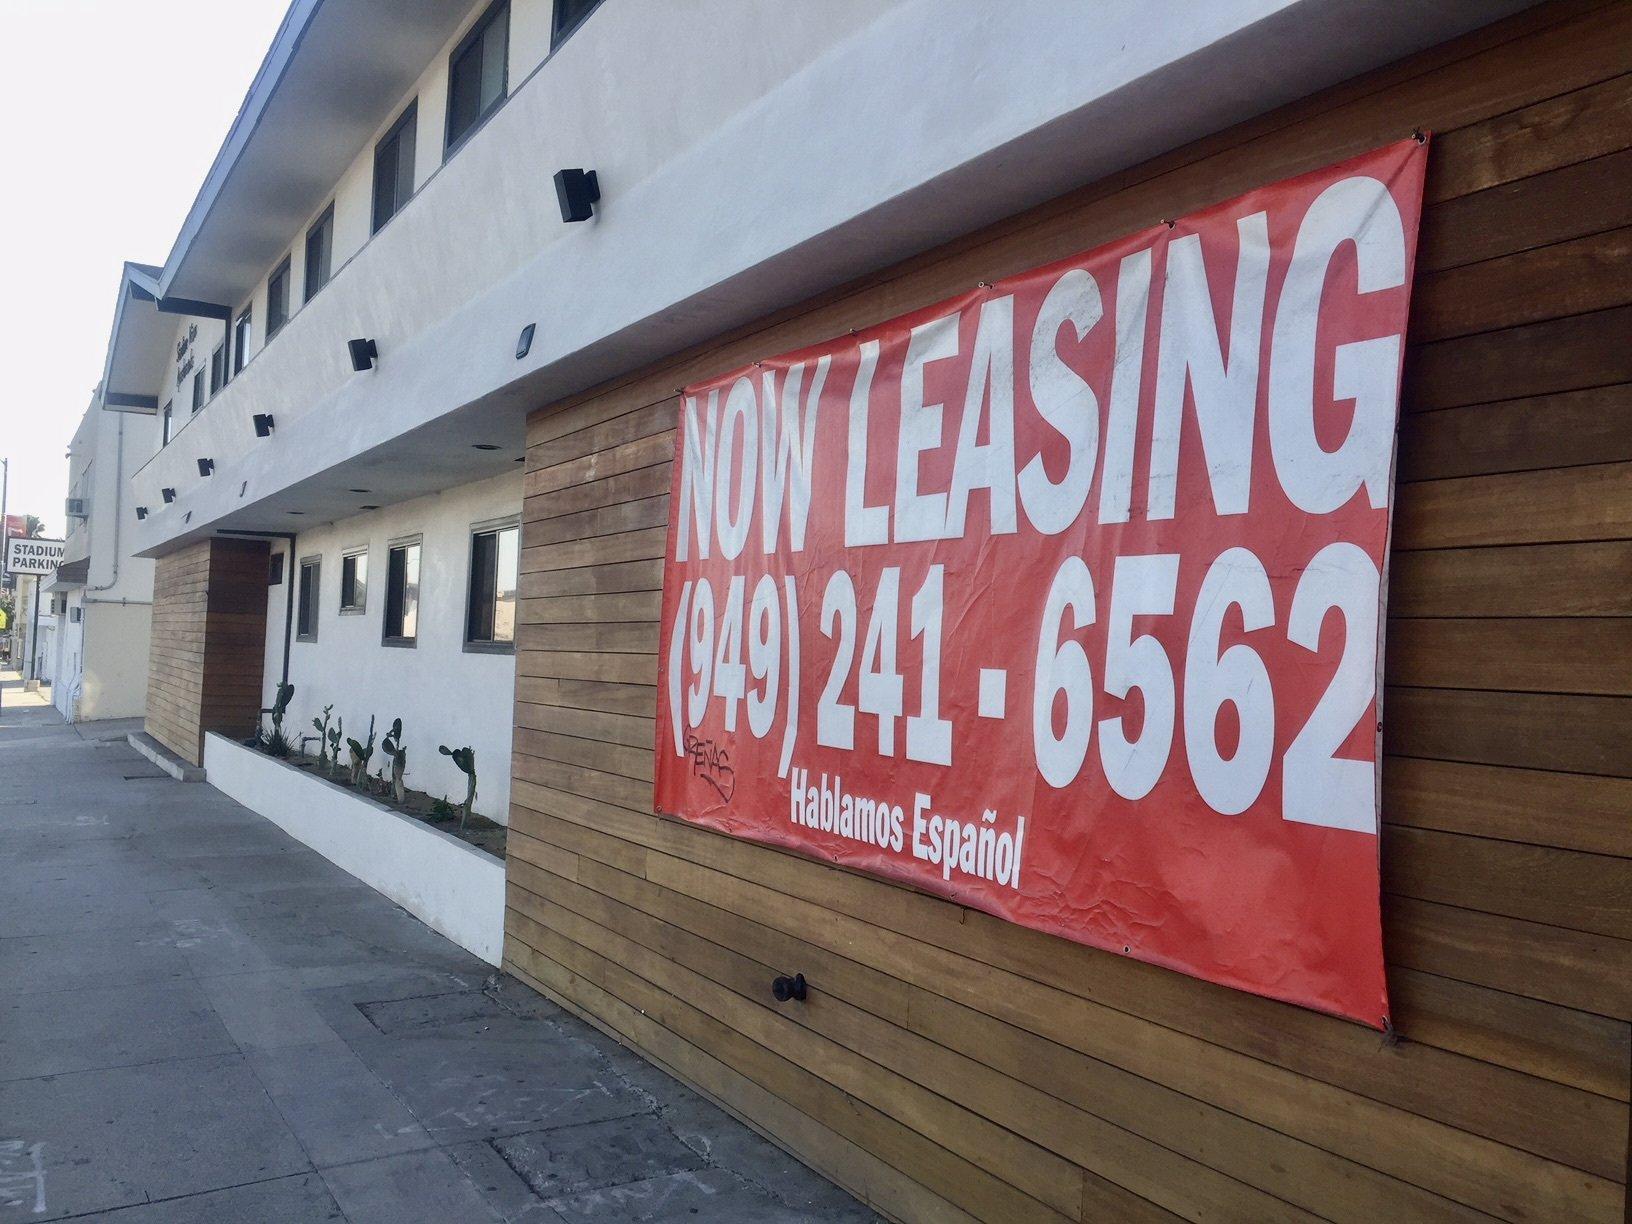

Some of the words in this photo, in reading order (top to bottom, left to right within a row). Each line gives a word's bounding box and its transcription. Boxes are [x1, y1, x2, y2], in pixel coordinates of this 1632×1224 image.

[675, 354, 832, 562] NOW
[845, 176, 1406, 548] LEASING
[14, 544, 65, 558] STADIUM
[668, 573, 800, 779] (949)
[790, 767, 904, 852] Hablamos
[912, 791, 1025, 890] Español
